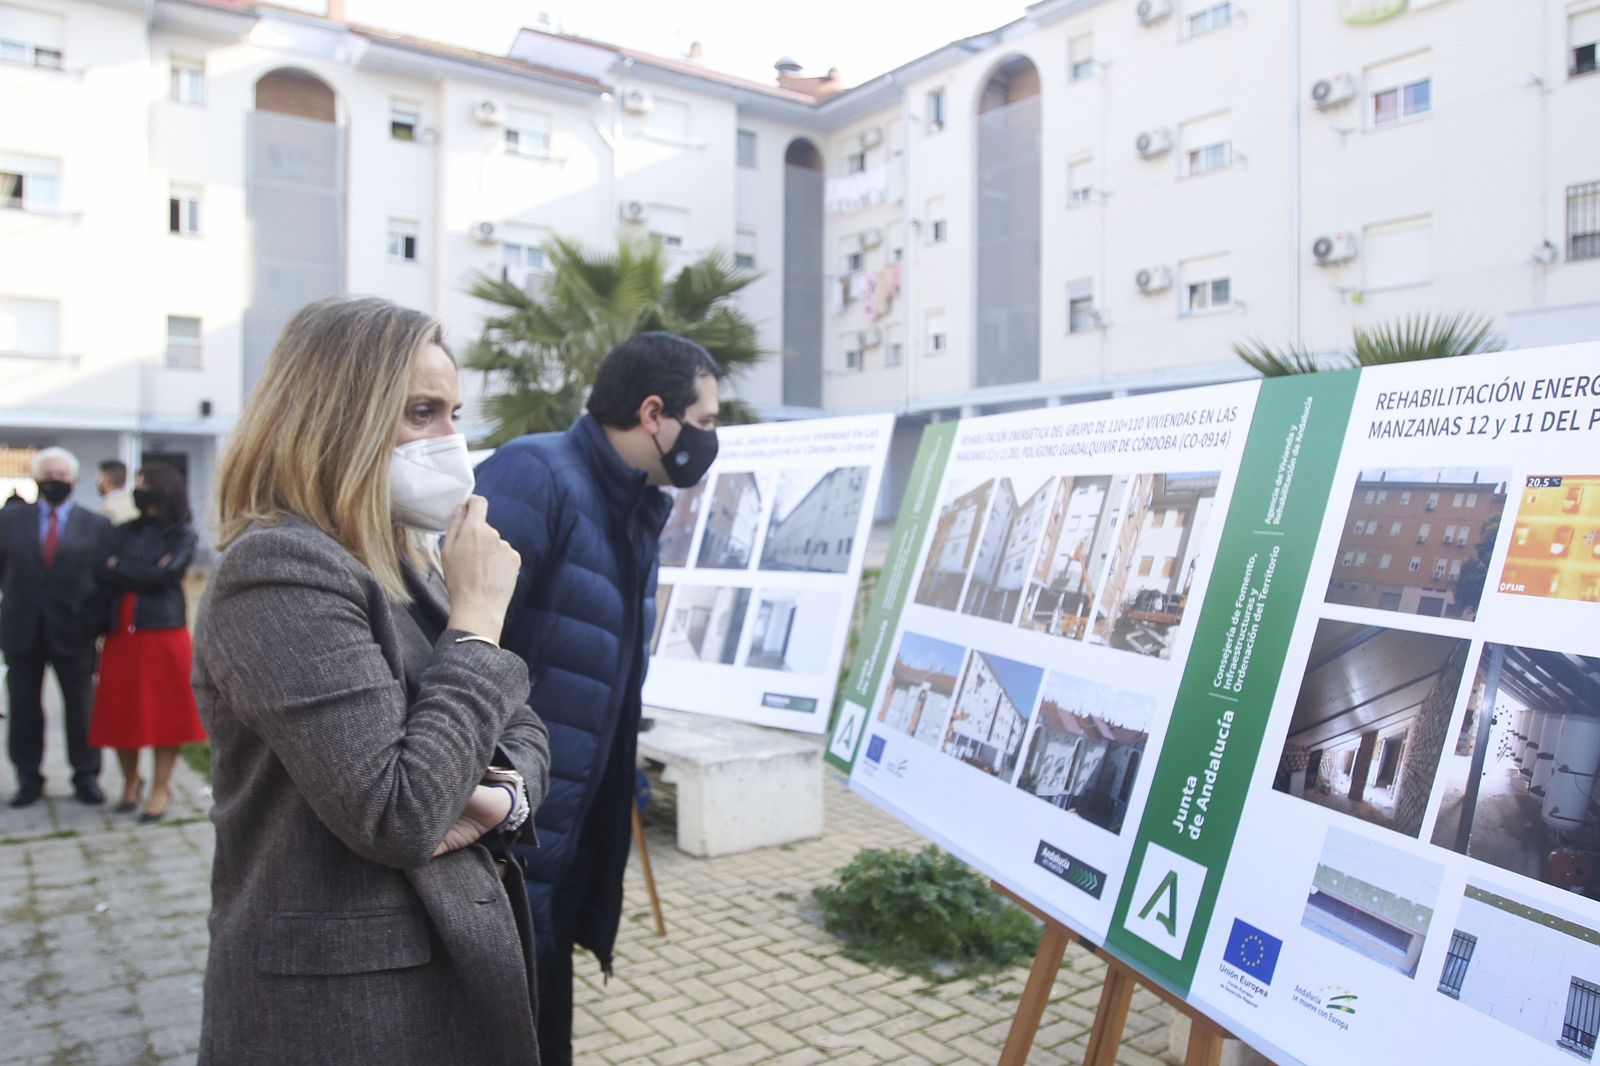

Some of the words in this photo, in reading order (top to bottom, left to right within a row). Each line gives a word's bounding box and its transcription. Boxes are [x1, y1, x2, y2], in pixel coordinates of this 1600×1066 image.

[1376, 376, 1526, 411] REHABILITACIÓN
[1066, 421, 1094, 437] GRUPO
[1095, 419, 1107, 434] DE
[1147, 410, 1197, 429] VIVIENDAS
[1199, 407, 1215, 425] EN
[1216, 405, 1238, 423] LAS
[1368, 416, 1463, 439] MANZANAS
[1466, 415, 1489, 435] 12
[1491, 418, 1506, 440] y
[1510, 412, 1534, 433] 11
[1540, 409, 1580, 432] DEL
[1118, 437, 1131, 453] DE
[1132, 433, 1177, 453] CÓRDOBA
[1179, 428, 1231, 453] (CO-0914)
[1528, 477, 1550, 487] 20.5
[1258, 545, 1280, 601] Territorio
[1253, 602, 1265, 622] del
[1213, 626, 1236, 688] Consejería
[1231, 609, 1241, 625] de
[1222, 597, 1256, 690] Infraestructuras
[1251, 587, 1259, 596] y
[1233, 624, 1259, 693] Ordenación
[1196, 710, 1235, 812] Andalucía
[1172, 775, 1198, 834] Junta
[1188, 814, 1205, 840] de
[1219, 963, 1239, 981] Unión
[1239, 975, 1269, 998] Europea
[1317, 1008, 1328, 1019] con
[1328, 1012, 1349, 1031] Europa
